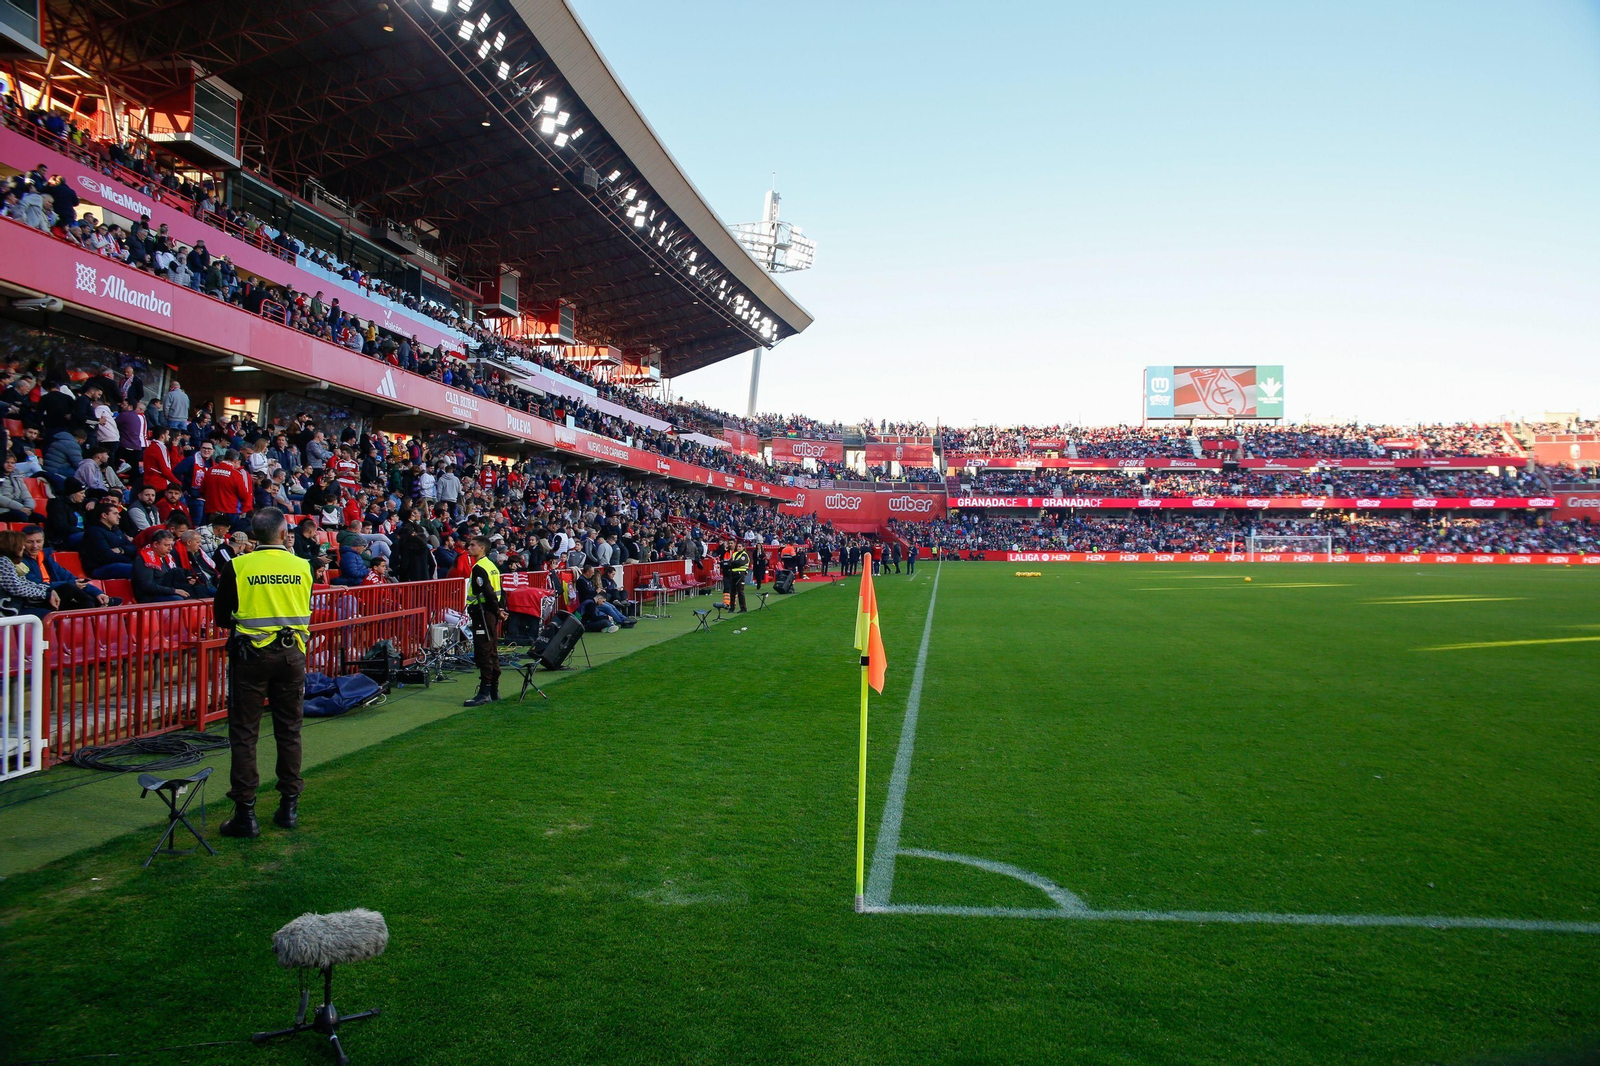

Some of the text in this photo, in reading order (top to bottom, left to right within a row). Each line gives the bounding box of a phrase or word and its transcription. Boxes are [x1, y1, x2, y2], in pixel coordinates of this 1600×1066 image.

[99, 183, 152, 218] MicaMotor
[100, 275, 172, 317] Alhambra
[445, 391, 478, 412] CAJA RURAL
[507, 413, 532, 435] PULEVA
[587, 441, 601, 453] NUEVO
[601, 444, 609, 456] LOS
[793, 442, 825, 458] wiber
[966, 459, 989, 467] HSN
[825, 493, 861, 510] wiber
[889, 496, 932, 512] wiber
[1568, 497, 1600, 507] Gree
[1009, 553, 1039, 561] LALIGA
[247, 574, 301, 585] VADISEGUR
